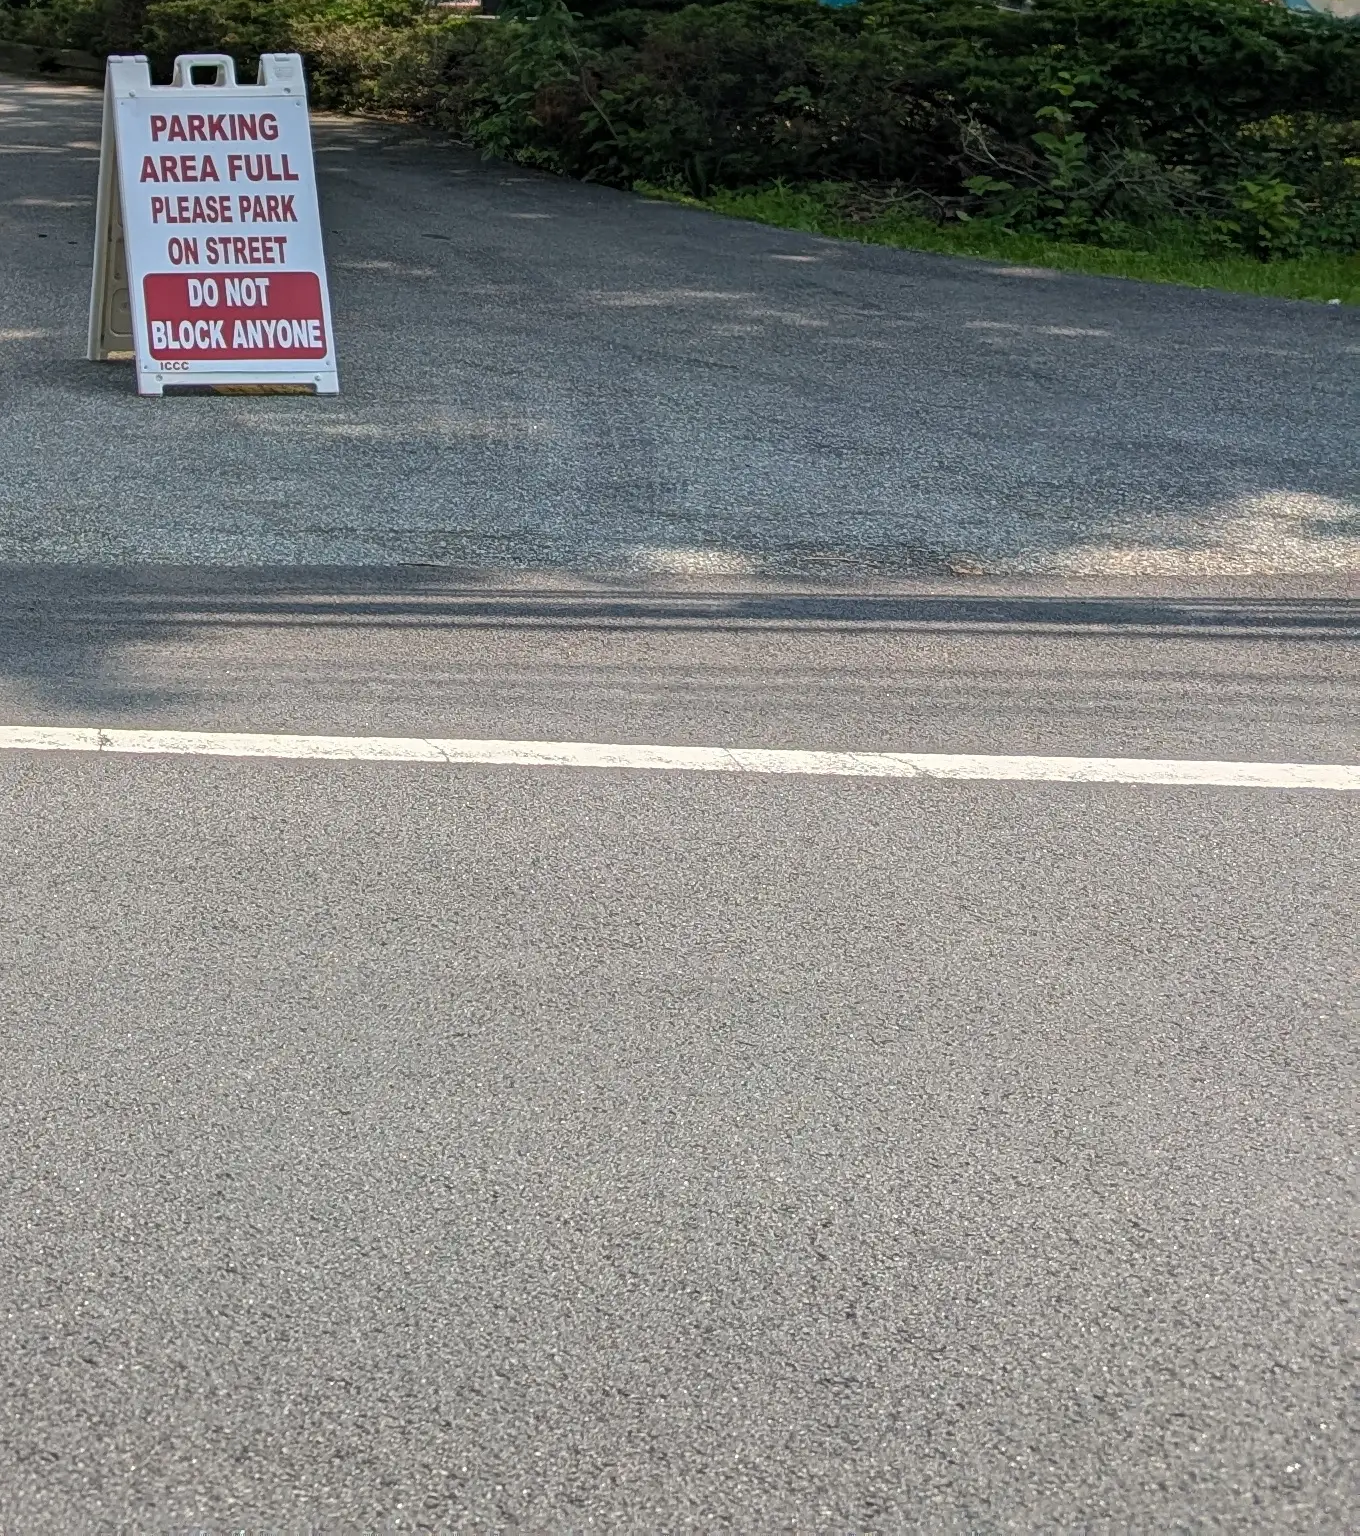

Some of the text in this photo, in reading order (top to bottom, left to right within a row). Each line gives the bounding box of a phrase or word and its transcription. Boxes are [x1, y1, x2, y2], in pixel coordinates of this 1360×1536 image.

[150, 113, 279, 142] PARKING
[140, 154, 299, 183] AREA FULL
[151, 194, 298, 224] PLEASE PARK
[168, 236, 287, 265] ON STREET
[187, 277, 269, 308] DO NOT
[151, 319, 322, 350] BLOCK ANYONE
[160, 361, 190, 371] ICCC
